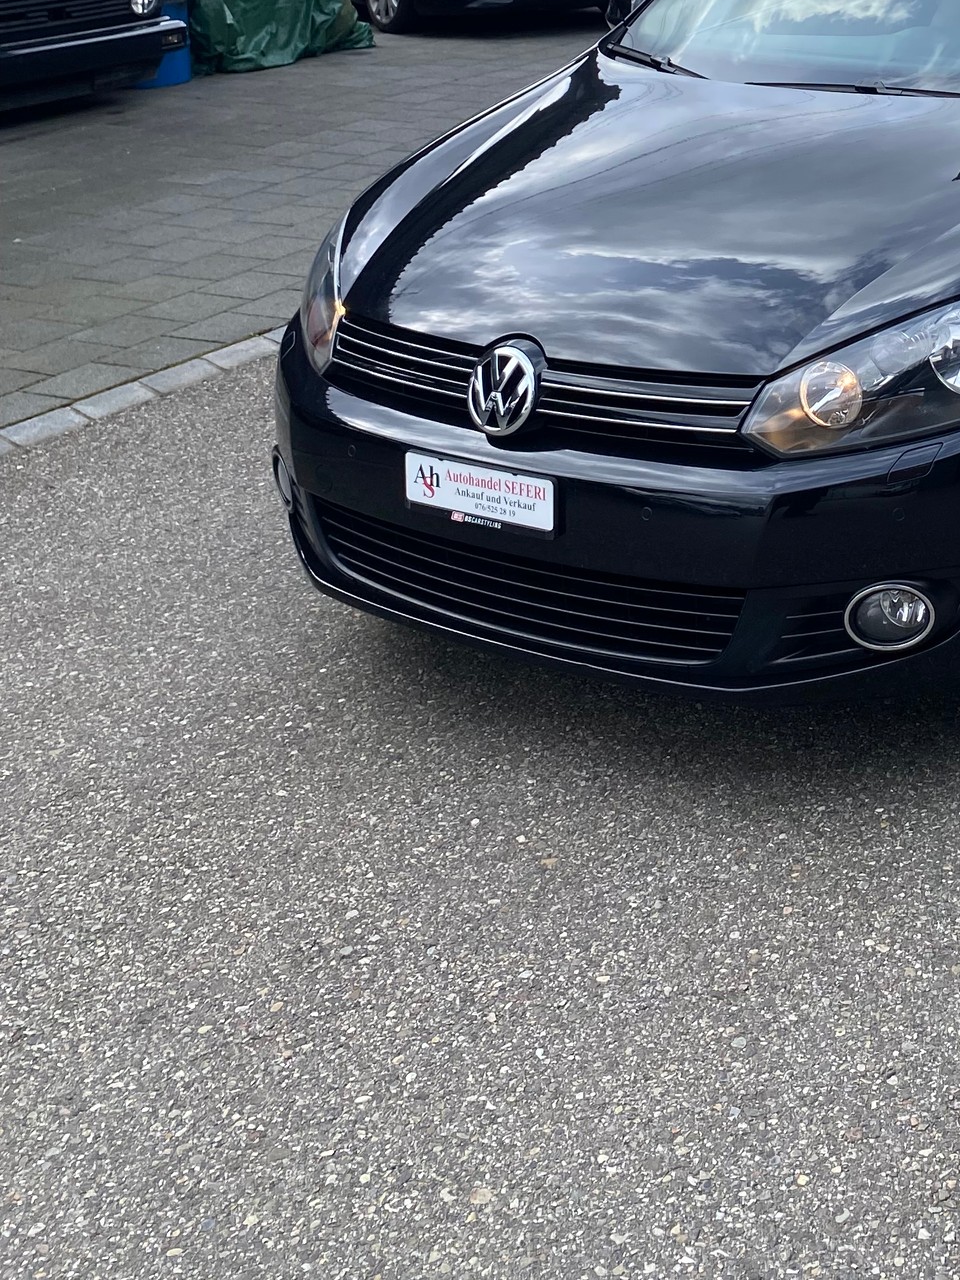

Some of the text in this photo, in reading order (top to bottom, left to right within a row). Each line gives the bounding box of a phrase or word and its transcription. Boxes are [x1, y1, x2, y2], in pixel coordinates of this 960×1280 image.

[445, 468, 546, 501] Autohandel SEFERI
[455, 487, 537, 511] Ankauf und Verkauf
